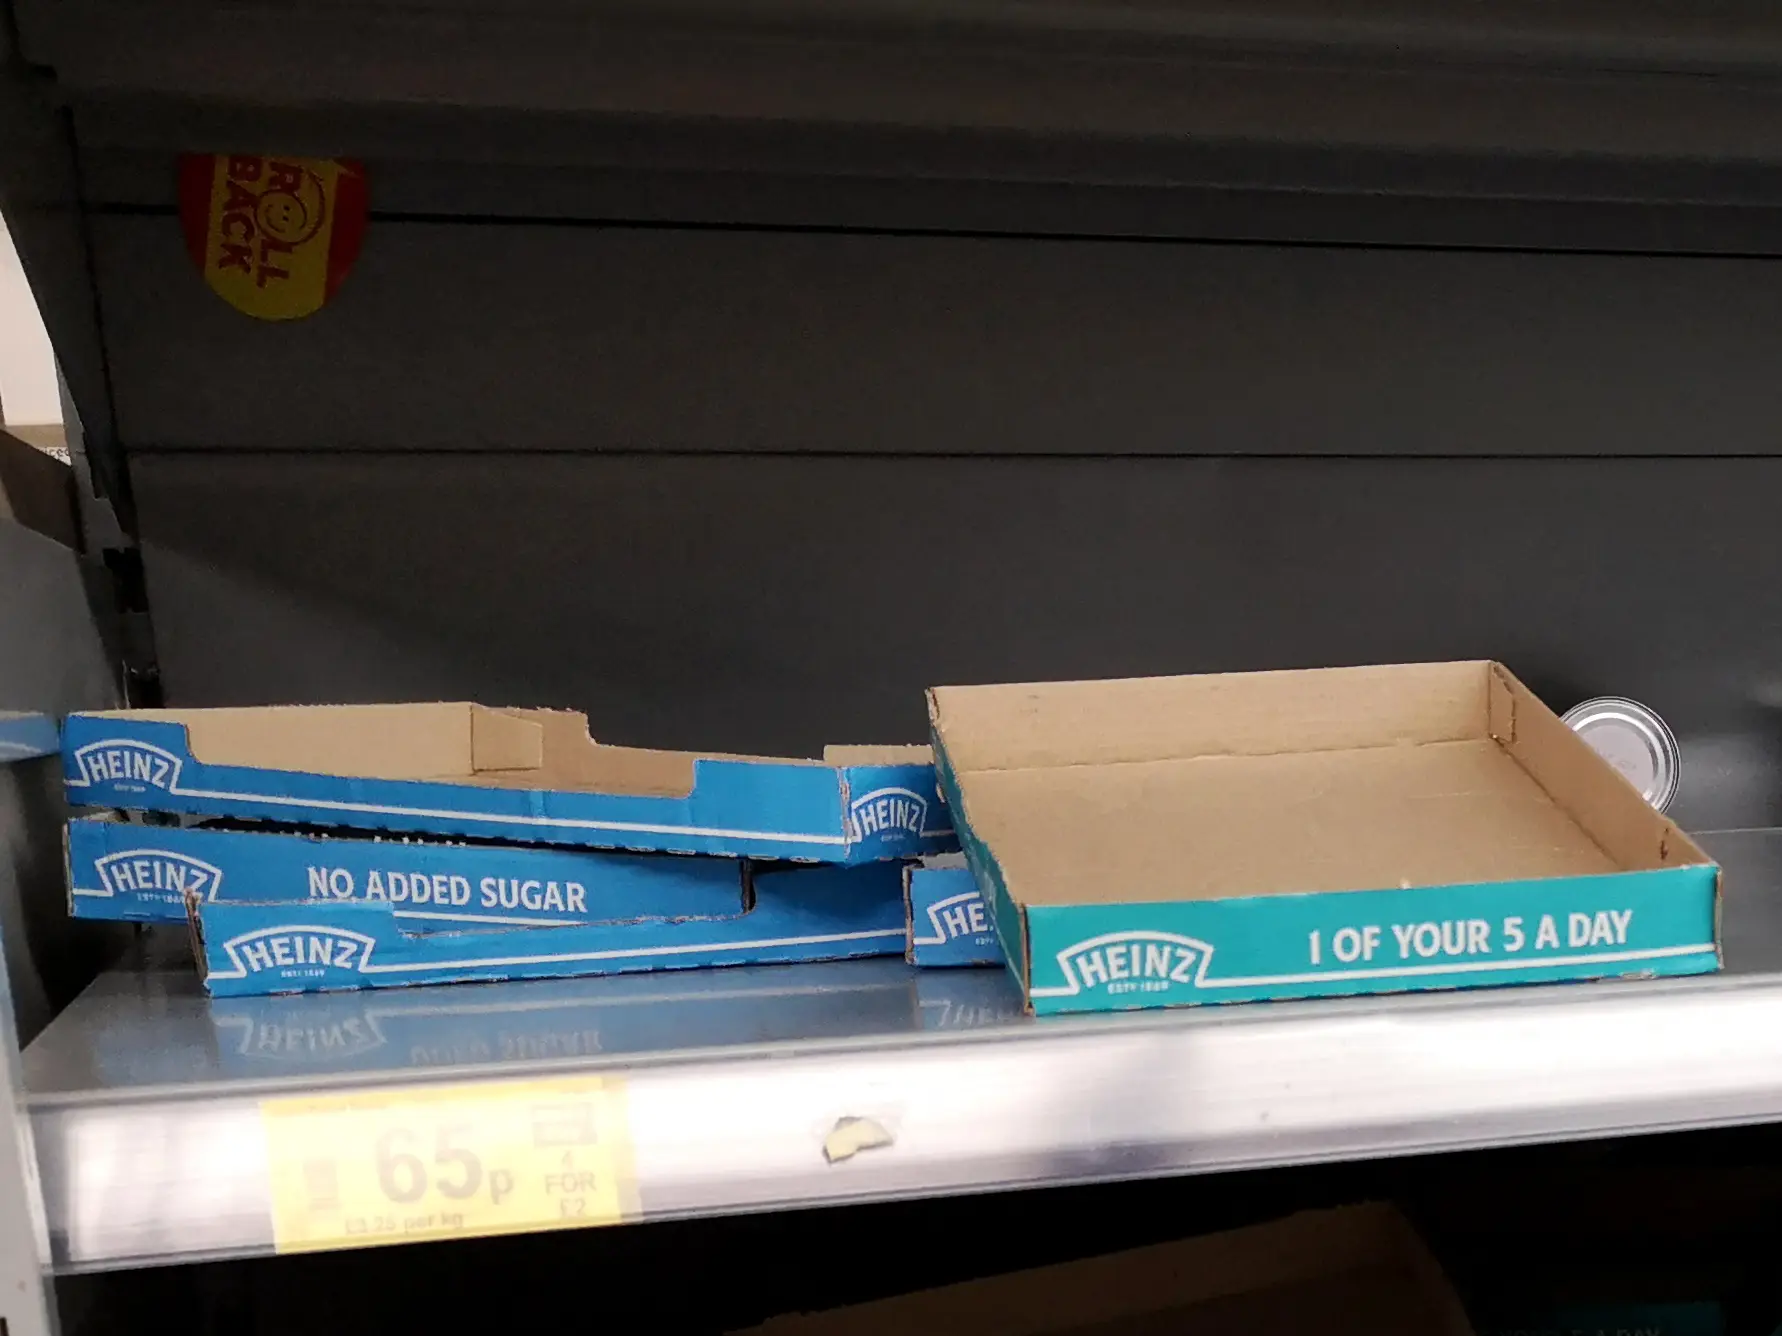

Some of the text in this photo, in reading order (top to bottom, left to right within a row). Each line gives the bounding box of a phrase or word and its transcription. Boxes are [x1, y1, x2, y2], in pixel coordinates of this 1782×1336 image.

[218, 156, 263, 275] BACK
[88, 749, 169, 788] HEINZ
[859, 800, 924, 834] HEINZ
[111, 859, 209, 904] HEINZ
[307, 866, 588, 913] NO ADDED SUGAR
[241, 935, 360, 973] HEINZ
[1307, 908, 1635, 966] 1 OF YOUR 5 A DAY
[1075, 944, 1195, 990] HEINZ
[376, 1122, 515, 1206] 65p
[544, 1171, 598, 1196] FOR
